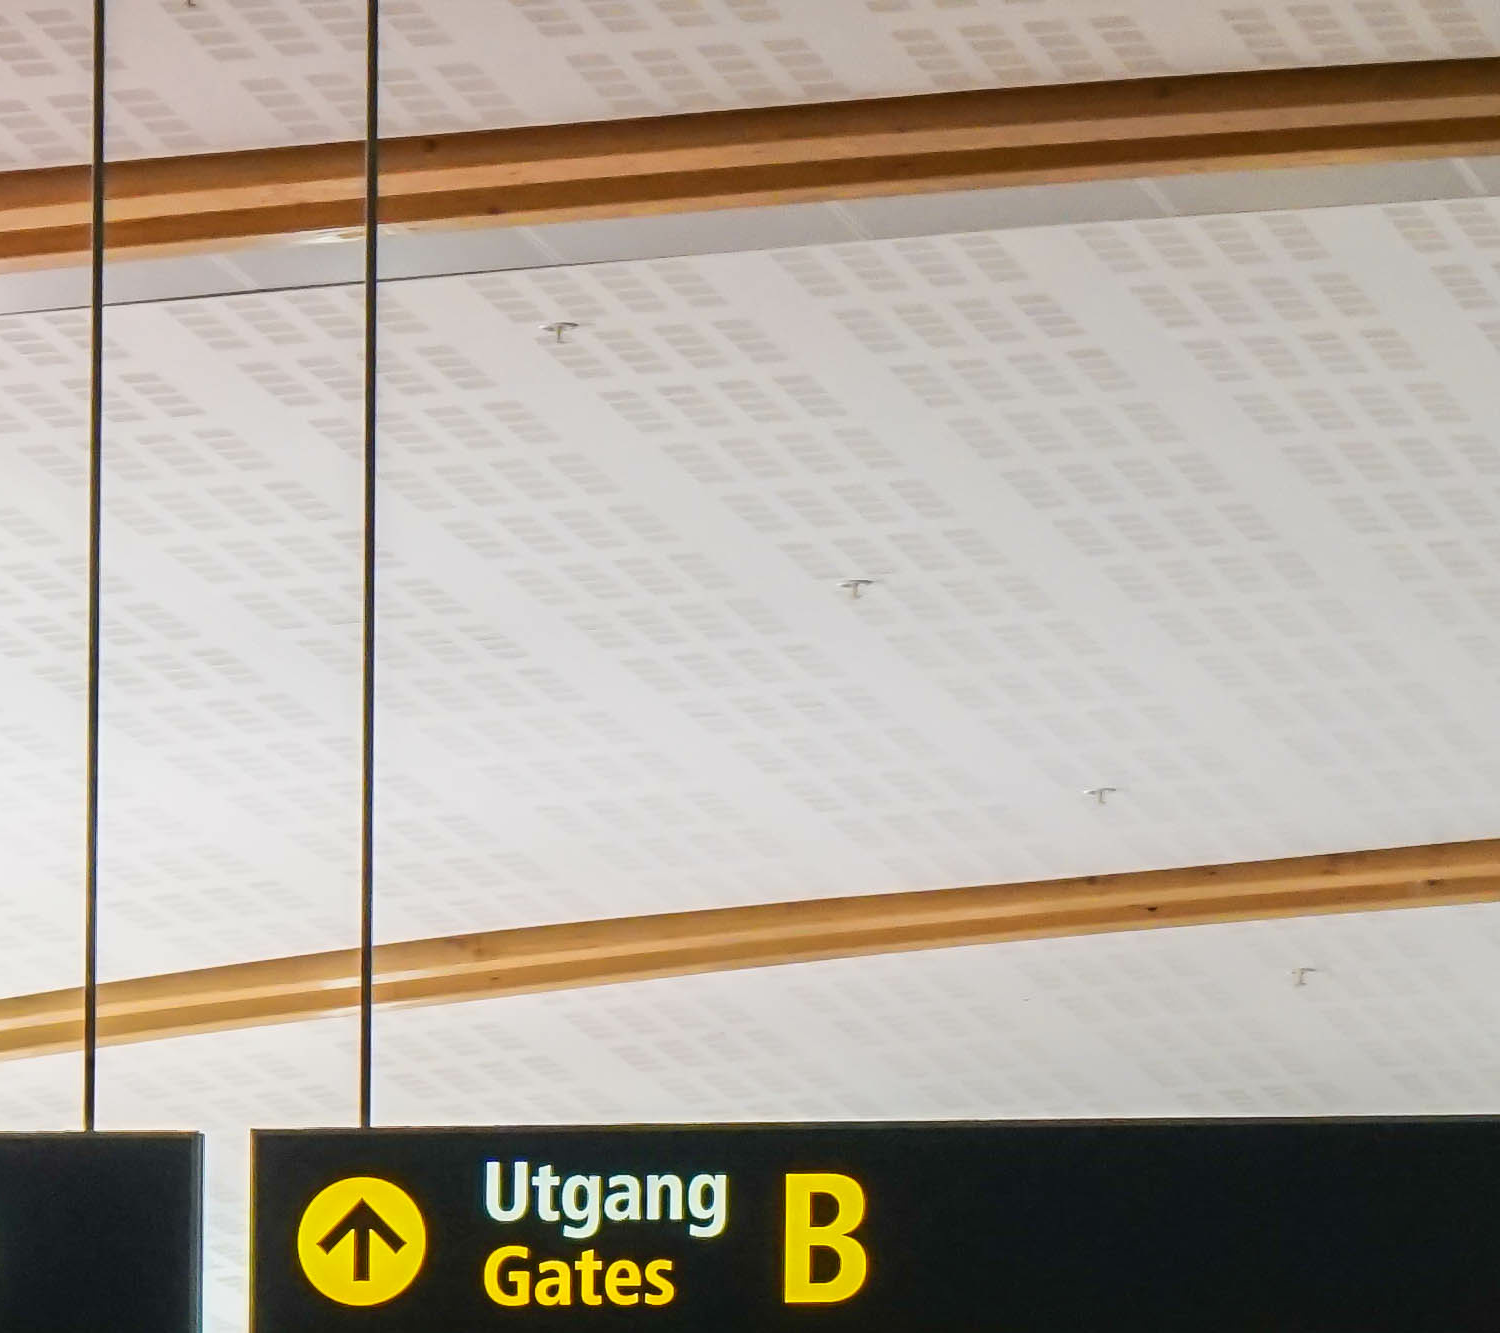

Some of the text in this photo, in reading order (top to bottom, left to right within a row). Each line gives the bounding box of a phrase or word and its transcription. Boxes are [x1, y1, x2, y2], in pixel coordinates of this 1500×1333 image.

[485, 1159, 727, 1239] Utgang
[784, 1173, 868, 1304] B
[483, 1246, 675, 1307] Gates
